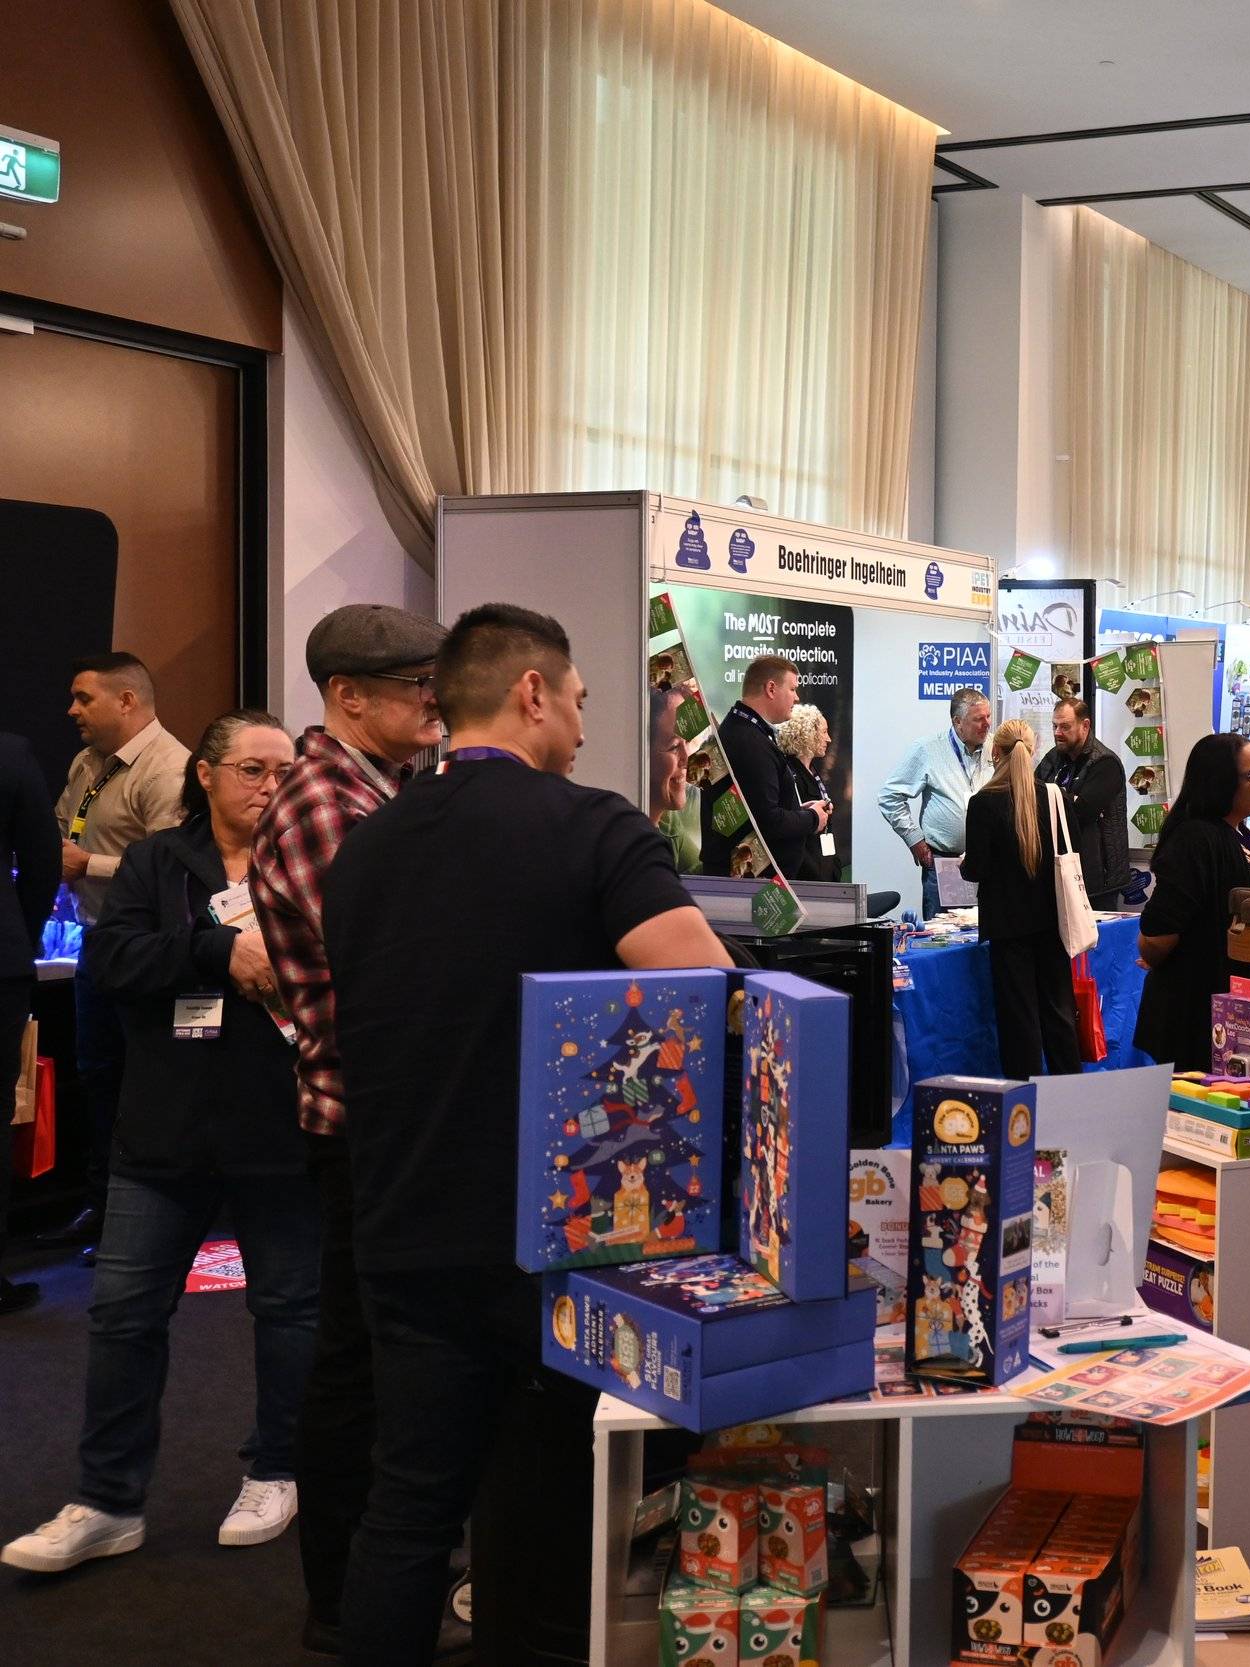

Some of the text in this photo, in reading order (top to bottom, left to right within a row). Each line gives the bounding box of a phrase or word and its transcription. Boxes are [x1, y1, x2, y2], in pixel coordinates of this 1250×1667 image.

[778, 545, 847, 580] Boehringer
[850, 557, 907, 587] Ingelheim
[724, 612, 836, 640] The MOST complete
[724, 643, 774, 661] parasite
[943, 647, 988, 667] PIAA
[724, 669, 736, 683] all
[929, 669, 954, 677] Industry
[954, 669, 990, 677] Association
[960, 1145, 985, 1154] PAWS
[880, 1165, 896, 1190] Bone
[1033, 1260, 1060, 1269] of the
[1143, 1269, 1184, 1296] EAT PUZZLE
[1036, 1287, 1053, 1295] Box
[1204, 1583, 1244, 1592] Book
